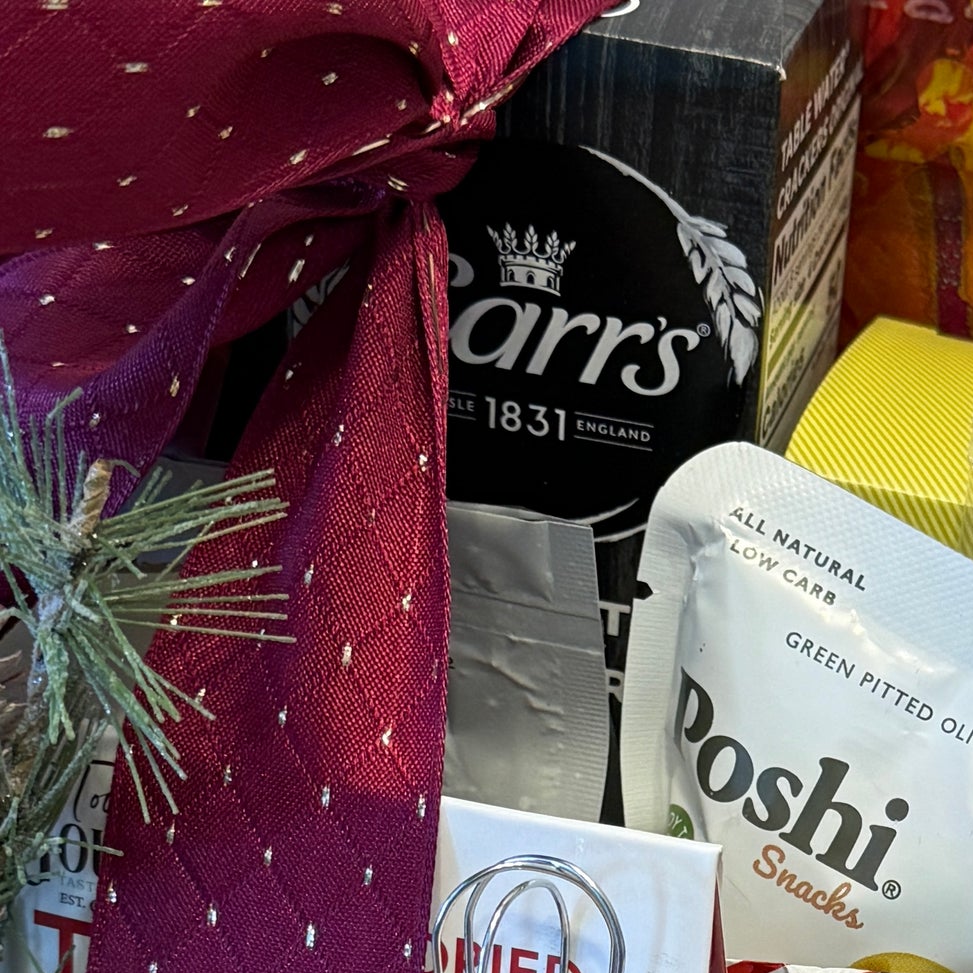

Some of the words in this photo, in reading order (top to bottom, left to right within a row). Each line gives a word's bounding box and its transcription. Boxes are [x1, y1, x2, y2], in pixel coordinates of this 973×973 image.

[485, 396, 566, 441] 1831
[576, 419, 650, 443] ENGLAND
[729, 507, 765, 536] ALL
[773, 529, 866, 591] NATURAL
[730, 539, 779, 572] LOW
[782, 569, 837, 606] CARB
[786, 631, 856, 679] GREEN
[860, 672, 934, 722] PITTED
[753, 844, 865, 930] Snacks
